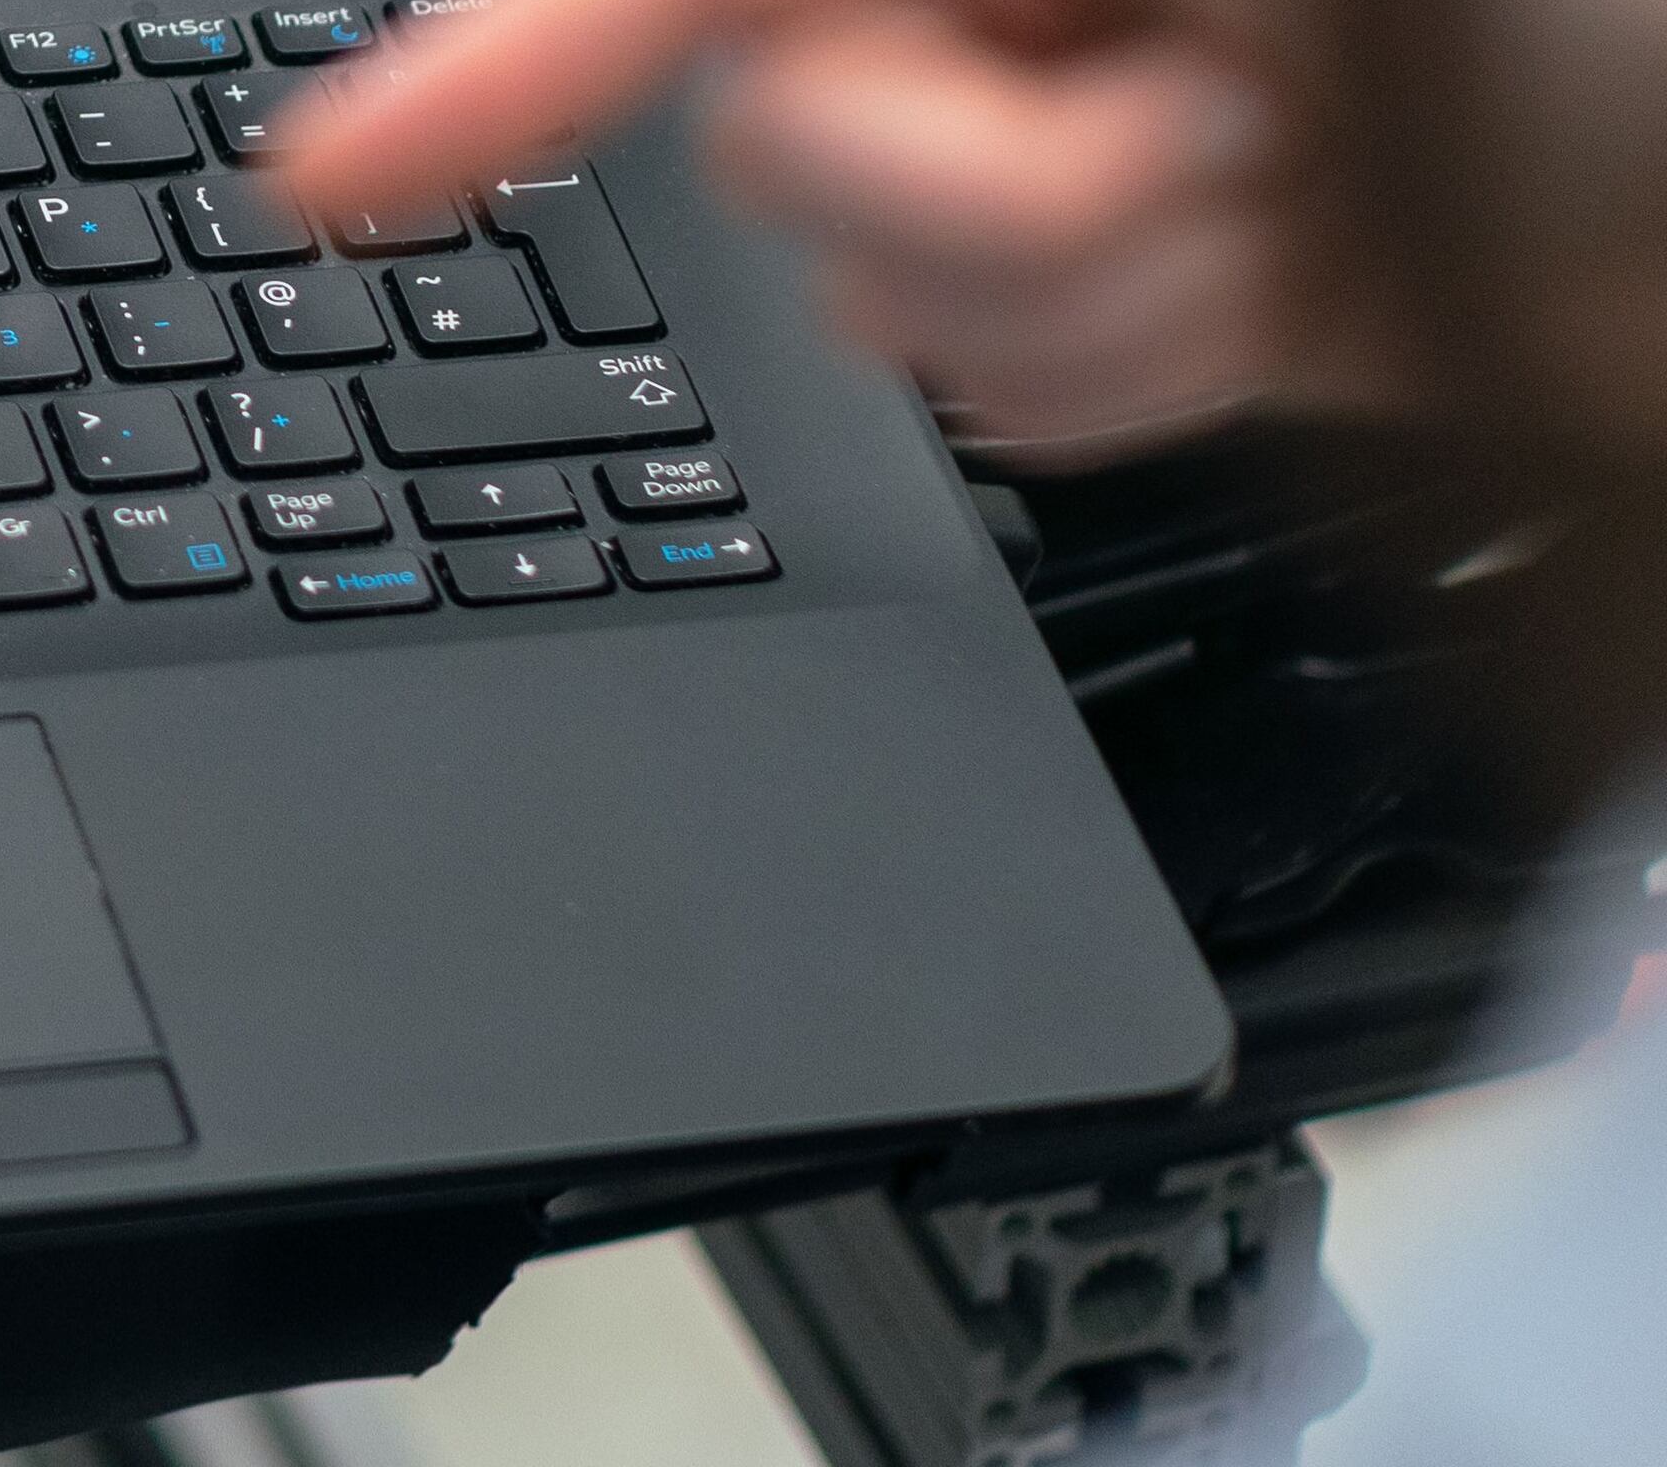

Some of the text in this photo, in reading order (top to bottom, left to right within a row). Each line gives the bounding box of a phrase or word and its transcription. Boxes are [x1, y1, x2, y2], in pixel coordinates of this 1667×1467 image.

[274, 7, 352, 29] Insert
[138, 16, 225, 40] PrtScr
[10, 32, 57, 48] F12
[39, 198, 68, 222] P
[600, 355, 665, 375] Shift
[645, 459, 712, 478] Page
[643, 479, 721, 496] Down
[268, 491, 333, 514] Page
[114, 506, 167, 525] Ctrl
[276, 512, 315, 528] Up
[662, 542, 714, 562] End
[337, 571, 416, 589] Home
